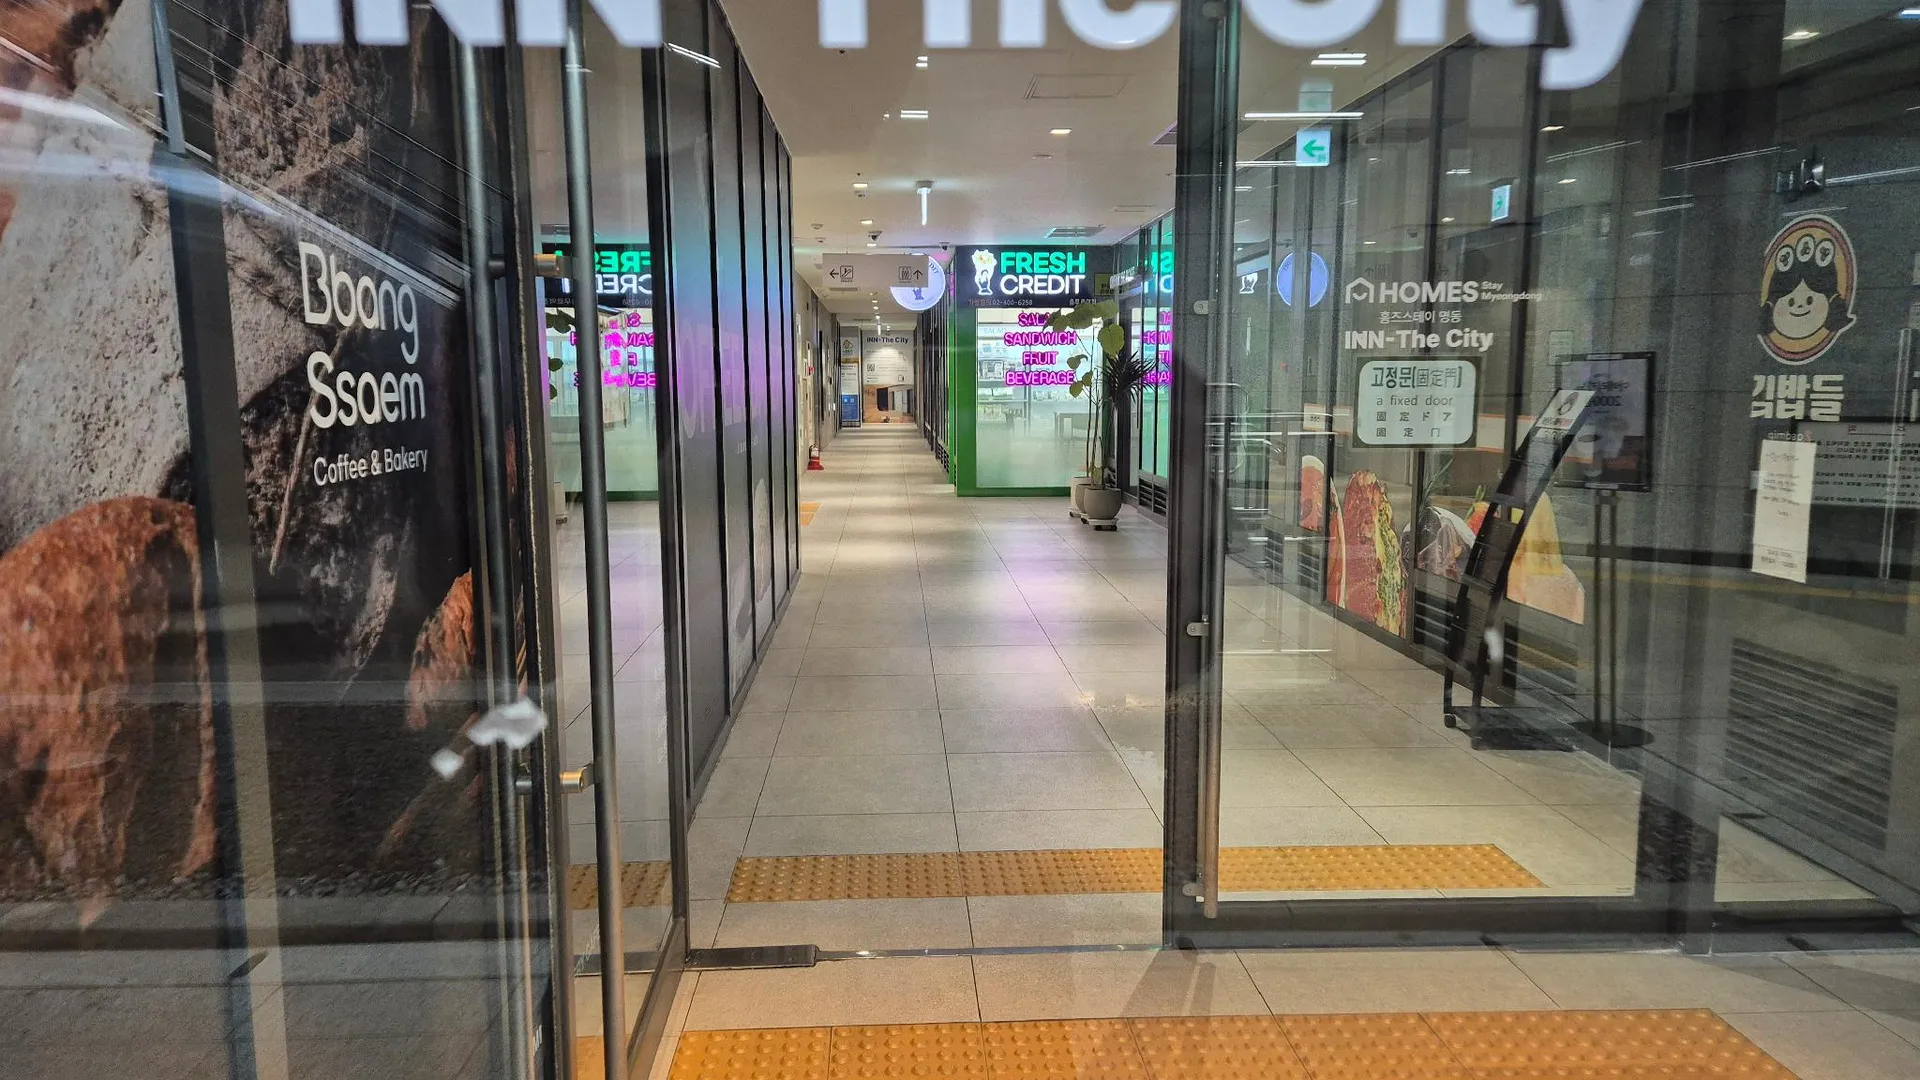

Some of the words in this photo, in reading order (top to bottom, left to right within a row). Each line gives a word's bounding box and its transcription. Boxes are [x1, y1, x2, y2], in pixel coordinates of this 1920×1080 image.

[1000, 252, 1086, 274] FRESH
[1000, 274, 1086, 295] CREDIT
[1379, 281, 1479, 303] HOMES
[1481, 281, 1503, 291] Stay
[299, 241, 419, 365] Bbang
[992, 299, 1033, 307] 02-400-6258
[1481, 292, 1542, 302] Myeongdong
[1018, 313, 1050, 326] SAL
[1379, 310, 1435, 324] 홈즈스테이
[1439, 310, 1462, 324] 명동
[1004, 331, 1077, 346] SANDWICH
[1345, 329, 1440, 349] INN-The
[1446, 328, 1494, 352] City
[1022, 351, 1058, 365] FRUIT
[1006, 370, 1075, 386] BEVERAGE
[307, 351, 426, 429] Ssaem
[1750, 374, 1844, 422] 김밥들
[1376, 397, 1383, 406] a
[1390, 395, 1418, 406] fixed
[1425, 395, 1453, 406] door
[313, 455, 368, 487] Coffee
[370, 449, 382, 476] &
[383, 446, 429, 473] Bakery
